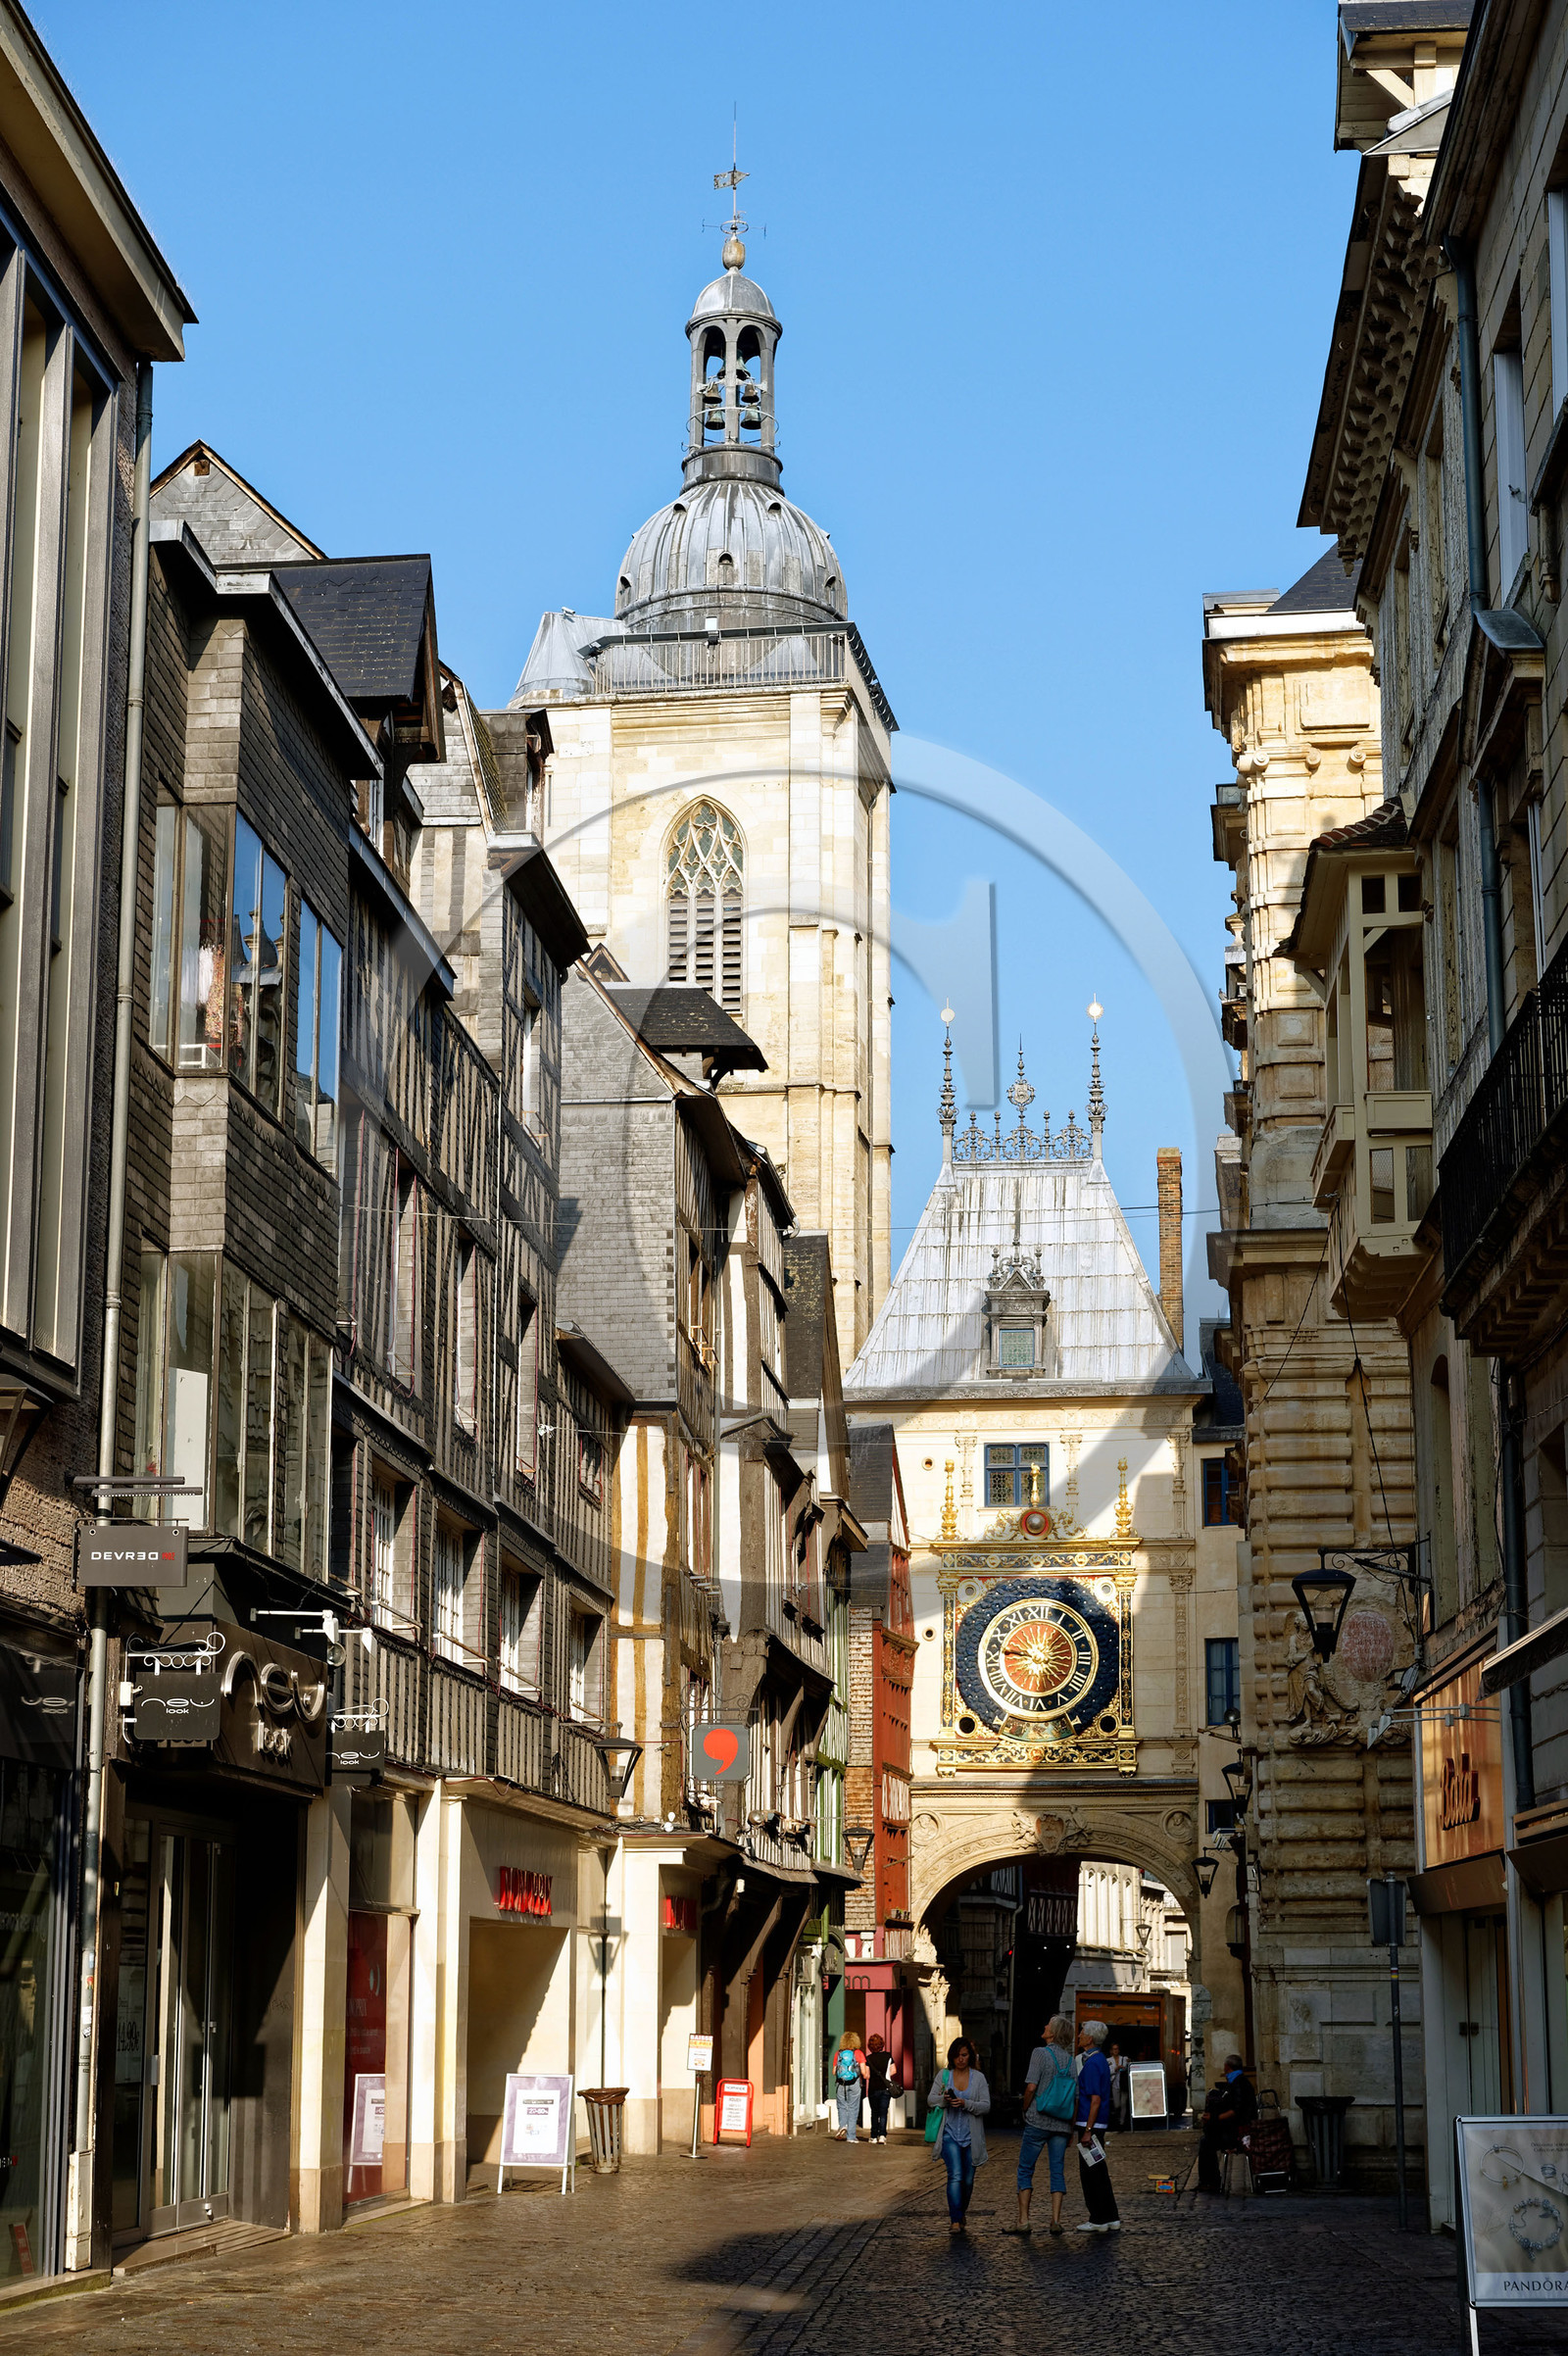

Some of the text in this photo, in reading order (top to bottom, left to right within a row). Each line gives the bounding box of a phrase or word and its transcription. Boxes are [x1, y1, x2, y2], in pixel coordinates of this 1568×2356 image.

[1005, 1610, 1024, 1629] XI
[1026, 1606, 1050, 1620] XII
[1071, 1629, 1086, 1642] II
[1078, 1650, 1092, 1666] III
